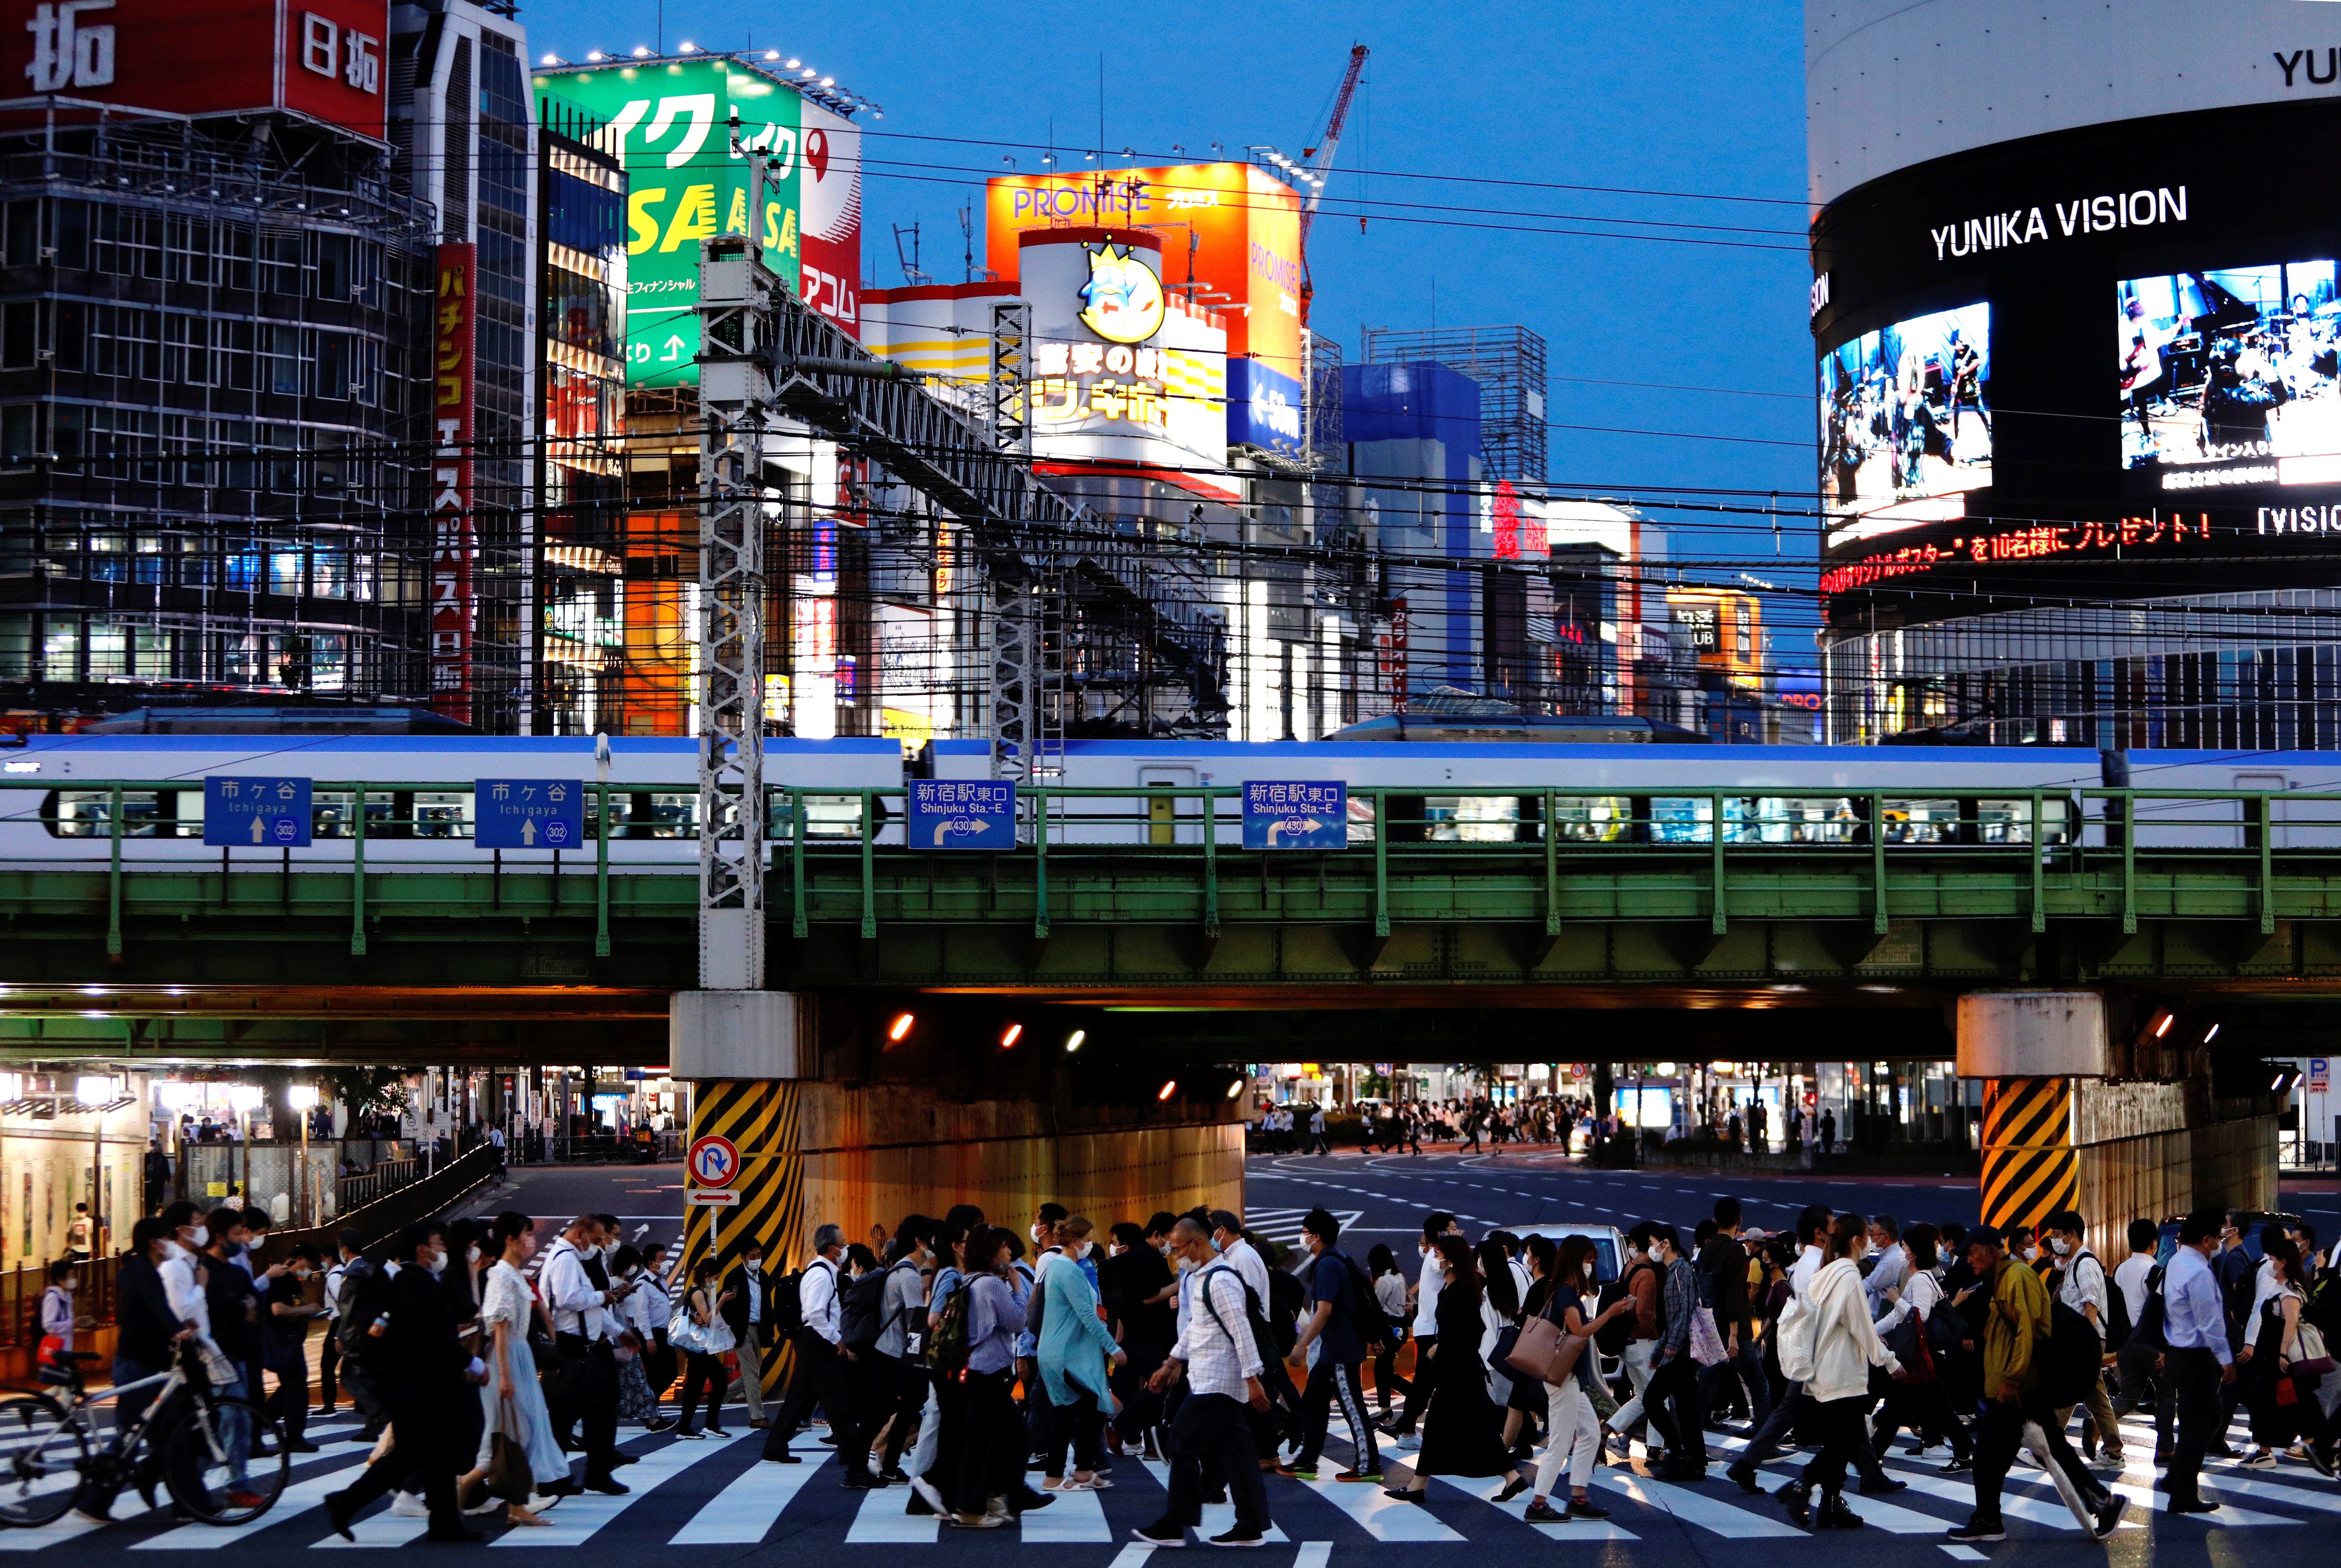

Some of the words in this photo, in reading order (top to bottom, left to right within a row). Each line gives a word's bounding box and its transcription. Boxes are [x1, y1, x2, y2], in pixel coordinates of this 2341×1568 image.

[303, 11, 379, 94] 日拓
[2274, 47, 2341, 87] YU
[730, 104, 796, 180] レイク
[1015, 183, 1151, 218] PROMISE
[726, 186, 797, 258] ASA
[1931, 208, 2049, 261] YUNIKA
[2055, 185, 2187, 237] VISION
[1251, 241, 1297, 294] PROMISE
[802, 264, 856, 325] アコム
[437, 263, 465, 405] パチンコ
[1268, 389, 1299, 438] 50m
[432, 417, 462, 690] エスパス日拓
[917, 783, 1007, 802] 新宿駅東口
[1250, 783, 1338, 802] 新宿駅東口
[229, 802, 286, 815] Ichigaya
[500, 805, 557, 816] Ichigaya
[921, 803, 965, 815] Shinjuku
[1253, 803, 1296, 815] Shinjuku
[279, 826, 294, 835] 302
[549, 827, 564, 837] 302
[953, 821, 969, 830] 430
[1286, 821, 1301, 830] 430
[2310, 1059, 2327, 1078] P
[591, 1095, 621, 1103] UBNADE
